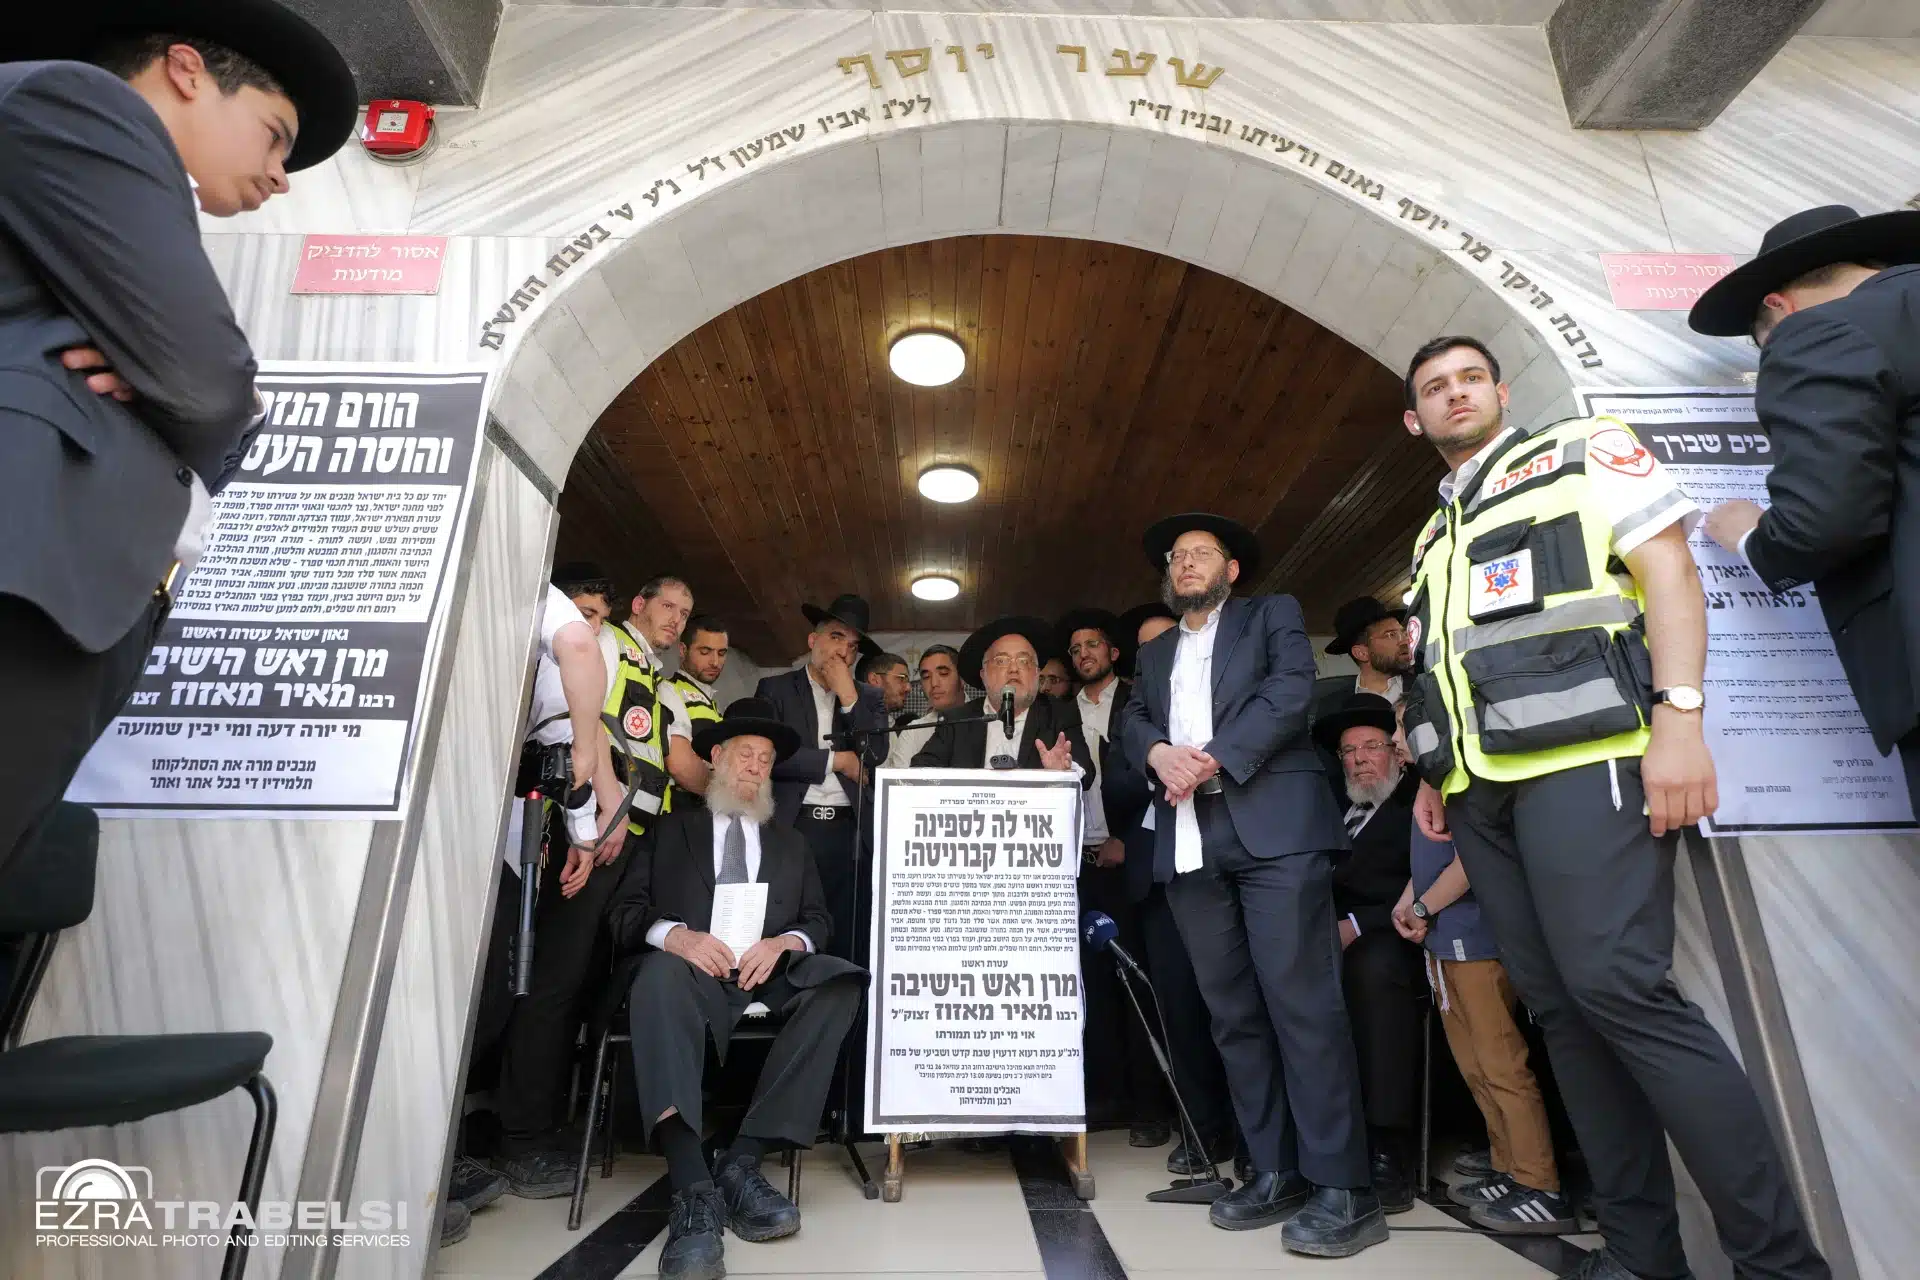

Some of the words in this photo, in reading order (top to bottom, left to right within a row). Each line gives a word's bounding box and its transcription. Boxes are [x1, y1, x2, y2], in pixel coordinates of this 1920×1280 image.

[836, 42, 996, 89] יוסף
[1056, 43, 1226, 89] שער
[882, 94, 932, 120] לע"נ
[817, 107, 871, 133] אביו
[1180, 108, 1233, 135] ובניו
[729, 123, 806, 168] שמעון
[1240, 123, 1320, 168] ורעיתו
[686, 156, 727, 180] ז"ל
[1325, 159, 1386, 201] גאנם
[1397, 197, 1449, 230] יוסף
[307, 242, 383, 260] להדביק
[390, 244, 440, 259] אסור
[1461, 231, 1493, 263] מר
[331, 267, 404, 282] מודעות
[1608, 262, 1677, 277] להדביק
[1685, 264, 1733, 277] אסור
[1499, 260, 1554, 310] היקר
[1549, 313, 1603, 368] נדבת
[335, 392, 420, 428] הורם
[1652, 434, 1721, 460] שברך
[328, 437, 454, 474] והוסרה
[1491, 454, 1553, 495] הצלה
[228, 490, 248, 498] לפיד
[250, 490, 265, 499] של
[299, 491, 312, 500] על
[313, 492, 327, 500] אנו
[357, 492, 384, 500] ישראל
[404, 491, 414, 500] כל
[416, 493, 429, 501] עם
[1483, 558, 1520, 577] הצלה
[214, 603, 240, 612] הארץ
[241, 603, 274, 612] שלמות
[275, 604, 298, 614] למען
[299, 604, 322, 613] ולחם
[322, 604, 355, 613] שפלים,
[356, 605, 372, 613] רוח
[373, 605, 396, 613] רומם
[182, 626, 226, 639] ראשנו
[228, 627, 272, 641] עטרת
[274, 627, 319, 640] ישראל
[321, 628, 349, 642] גאון
[254, 648, 326, 675] ראש
[333, 648, 388, 682] מרן
[171, 681, 262, 706] מאזוז
[274, 682, 354, 707] מאיר
[358, 694, 395, 708] רבנו
[117, 722, 182, 735] שמועה
[187, 722, 220, 738] יבין
[226, 723, 252, 736] ומי
[256, 723, 295, 738] דעה
[300, 724, 337, 737] יורה
[342, 724, 361, 737] מי
[152, 757, 218, 771] הסתלקותו
[221, 759, 242, 771] את
[245, 759, 273, 771] מרה
[276, 760, 316, 771] מבכים
[150, 776, 181, 788] ואתר
[185, 777, 212, 788] אתר
[217, 775, 240, 789] בכל
[245, 777, 259, 789] די
[262, 776, 312, 789] תלמידיו
[915, 810, 985, 837] לספינה
[991, 810, 1017, 838] לה
[1023, 814, 1053, 838] אוי
[904, 840, 997, 873] קברניטה!
[1003, 843, 1063, 867] שאבד
[986, 960, 1008, 968] עטרת
[891, 973, 975, 996] הישיבה
[982, 973, 1034, 996] ראש
[1040, 973, 1077, 1001] מרן
[891, 1008, 929, 1021] זצוק"ל
[934, 1003, 994, 1020] מאזוז
[1001, 1003, 1052, 1020] מאיר
[1056, 1011, 1077, 1020] רבנו
[935, 1030, 970, 1039] תמורתו
[973, 1029, 987, 1039] לנו
[989, 1030, 1004, 1040] יתן
[1006, 1030, 1018, 1039] מי
[1020, 1030, 1035, 1039] אוי
[889, 1048, 906, 1056] פסח
[908, 1047, 921, 1056] של
[923, 1048, 950, 1057] ושביעי
[951, 1049, 970, 1058] קדש
[972, 1049, 990, 1057] שבת
[1018, 1049, 1037, 1057] רעוא
[1039, 1049, 1056, 1057] בעת
[1057, 1047, 1079, 1057] נלב"ע
[966, 1086, 991, 1094] ומבכים
[993, 1085, 1020, 1094] האבלים
[959, 1096, 995, 1105] ותלמידהון
[996, 1097, 1011, 1106] רבנן
